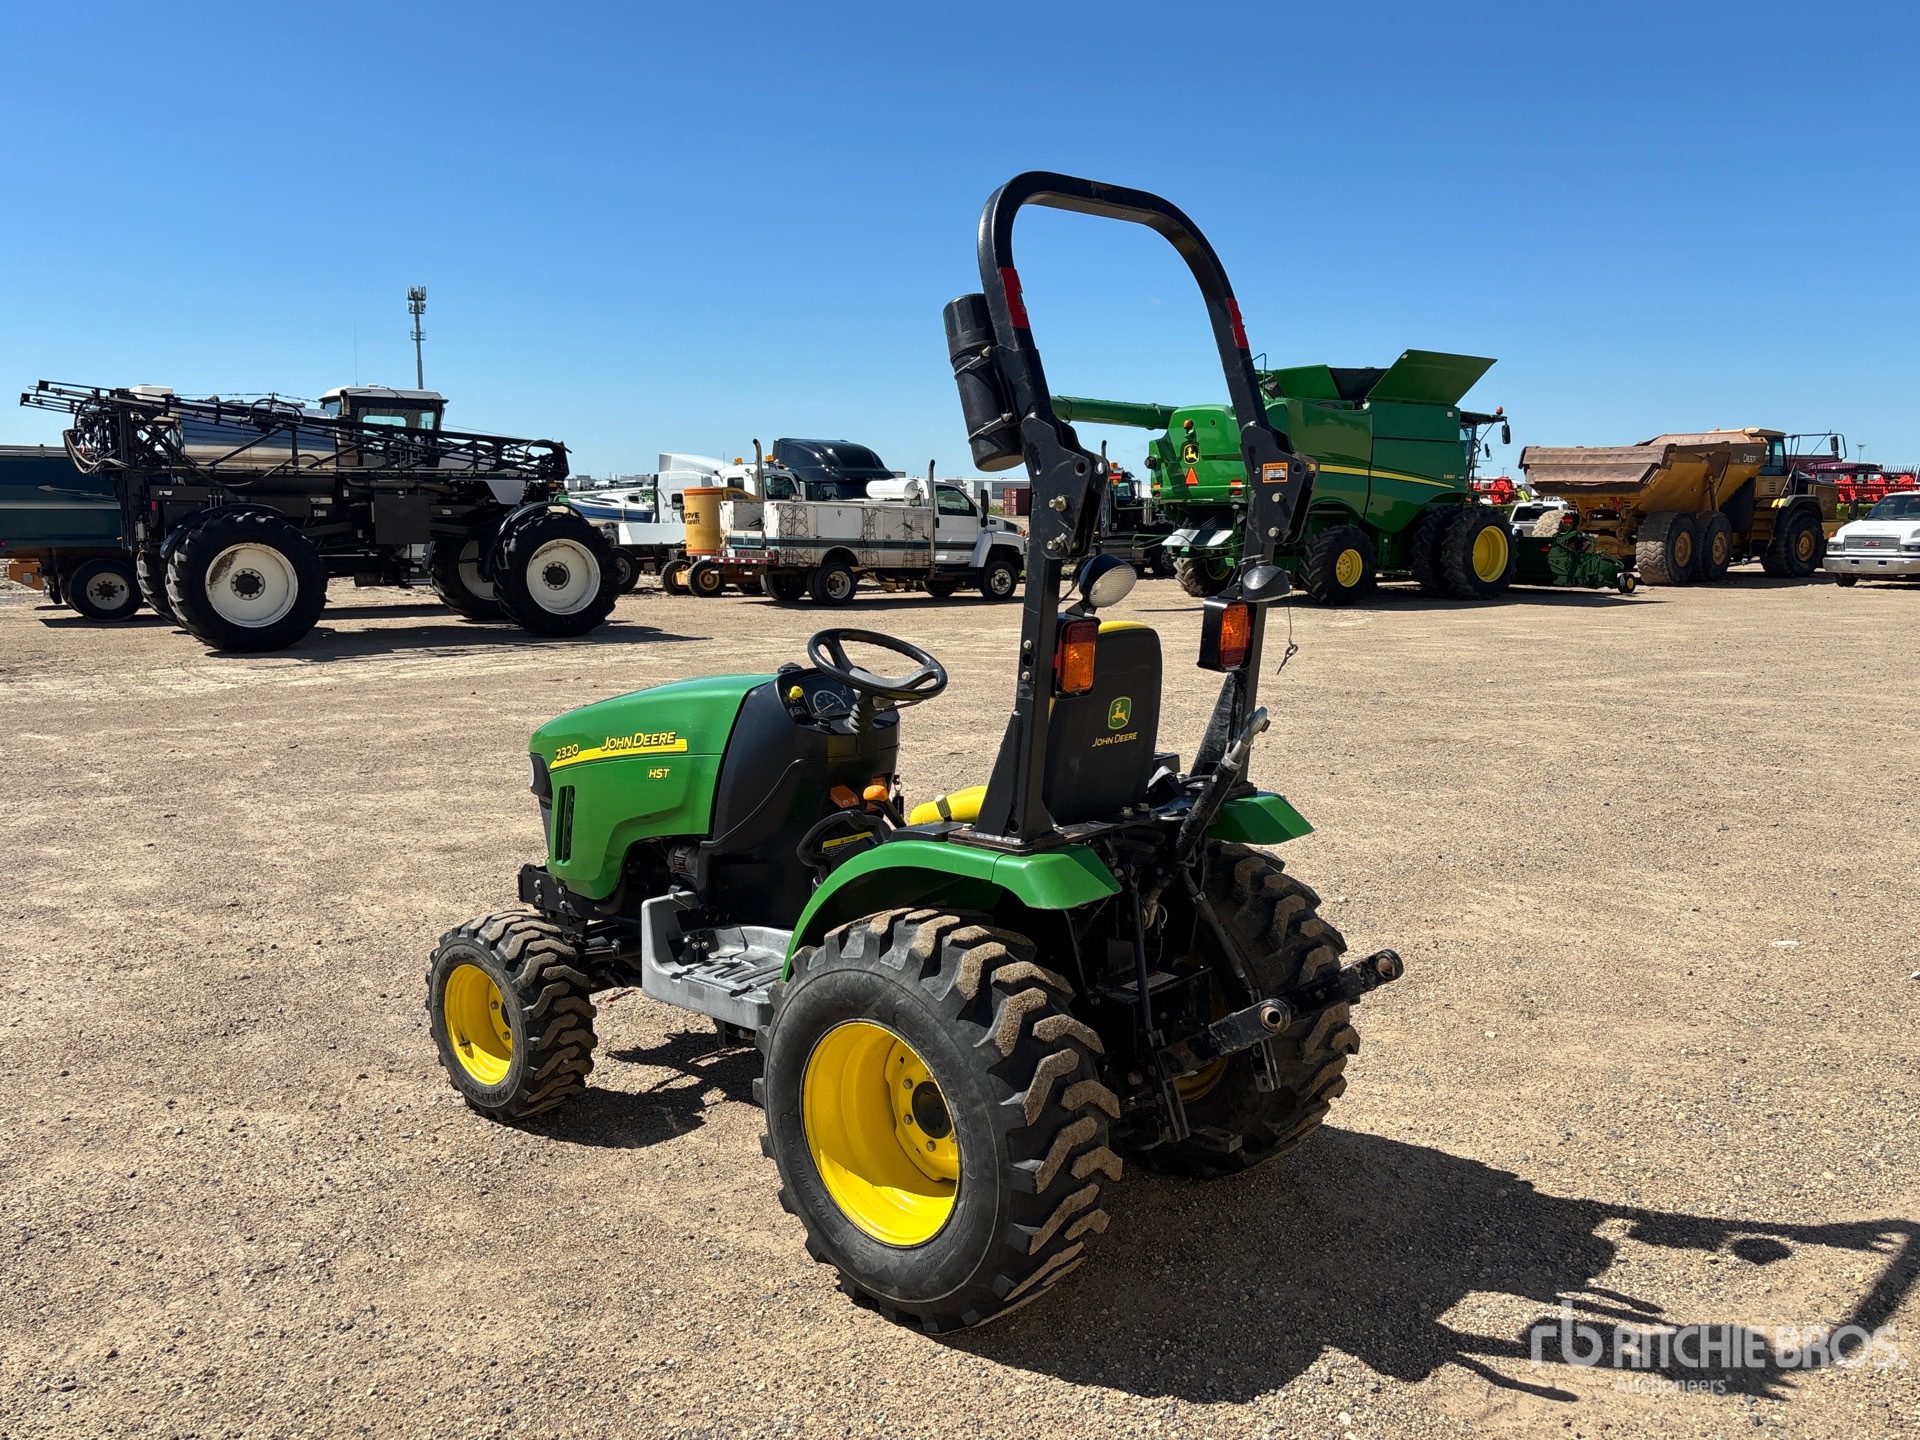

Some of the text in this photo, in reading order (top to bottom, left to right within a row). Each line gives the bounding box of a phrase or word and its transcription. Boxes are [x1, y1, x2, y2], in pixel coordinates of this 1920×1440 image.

[601, 731, 677, 751] JOHN DEERE
[1091, 732, 1138, 748] JOHN DEERE
[556, 744, 579, 759] 2320
[648, 768, 671, 779] HST
